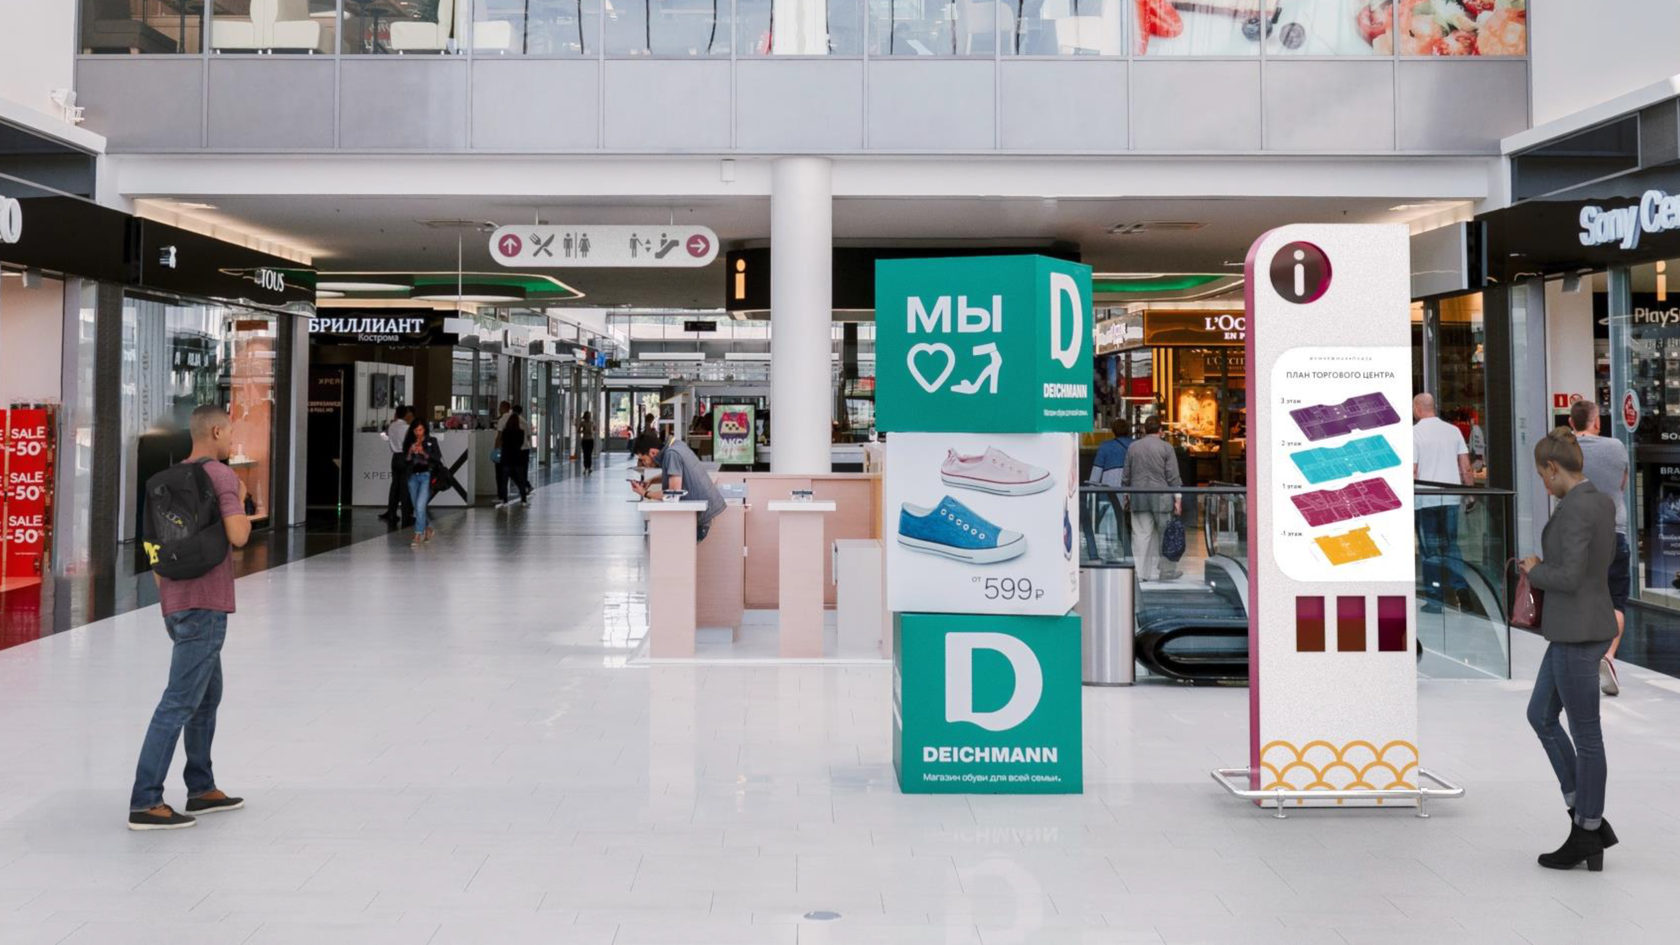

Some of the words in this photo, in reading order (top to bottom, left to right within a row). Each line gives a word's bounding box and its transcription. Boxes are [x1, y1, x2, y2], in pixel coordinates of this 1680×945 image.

[1578, 205, 1640, 249] Sony
[260, 269, 285, 292] TOUS
[907, 295, 1003, 333] МЫ
[1050, 272, 1083, 369] D
[1634, 307, 1680, 328] PlayS
[308, 318, 424, 333] БРИЛЛИАНТ
[358, 333, 399, 344] Кострома
[1224, 332, 1237, 340] EN
[1286, 371, 1310, 379] ПЛАН
[1312, 371, 1361, 379] ТОРГОВОГО
[1363, 371, 1395, 380] ЦЕНТРА
[1043, 383, 1088, 399] DEICHMANN
[11, 426, 46, 440] SALE
[1660, 432, 1680, 440] SO
[9, 472, 44, 484] SALE
[8, 515, 43, 527] SALE
[945, 631, 1043, 732] D
[923, 746, 1058, 763] DEICHMANN
[923, 773, 961, 782] Магазин
[963, 773, 988, 784] обуви
[989, 774, 1007, 783] для
[1008, 773, 1030, 782] всей
[1031, 774, 1062, 782] семьи.
